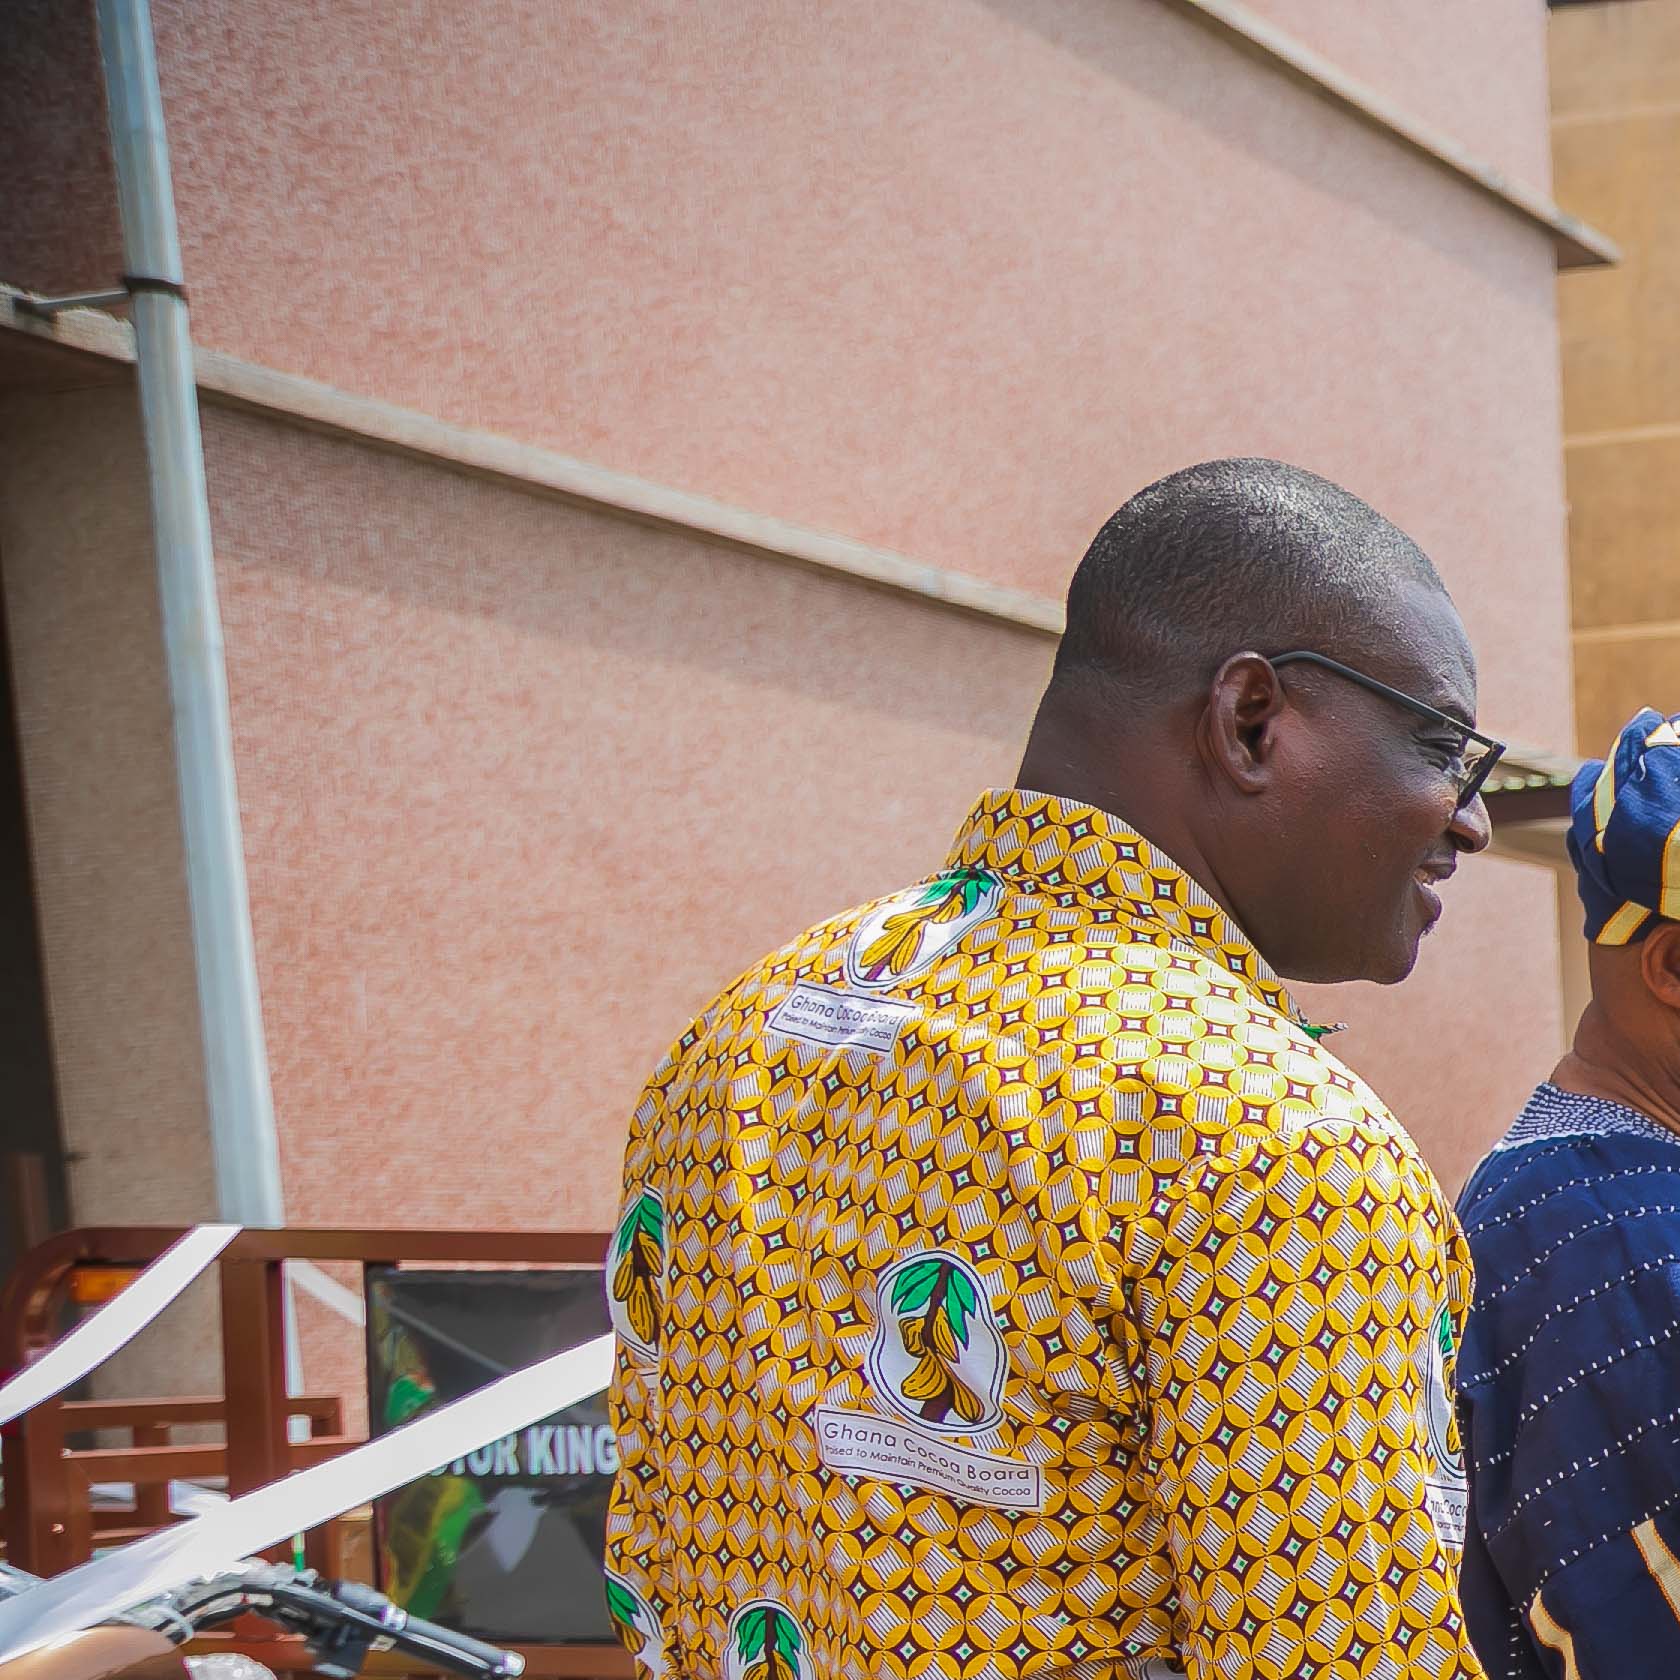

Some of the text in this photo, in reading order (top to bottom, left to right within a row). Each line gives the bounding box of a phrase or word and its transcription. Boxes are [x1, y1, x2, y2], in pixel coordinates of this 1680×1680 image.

[791, 995, 835, 1018] Ghana
[527, 1424, 620, 1475] KING
[823, 1422, 1030, 1482] Ghana Cocoa Board
[856, 1448, 867, 1458] to
[869, 1451, 916, 1469] Maintain
[917, 1462, 956, 1484] Premium
[992, 1485, 1031, 1496] Cocoa
